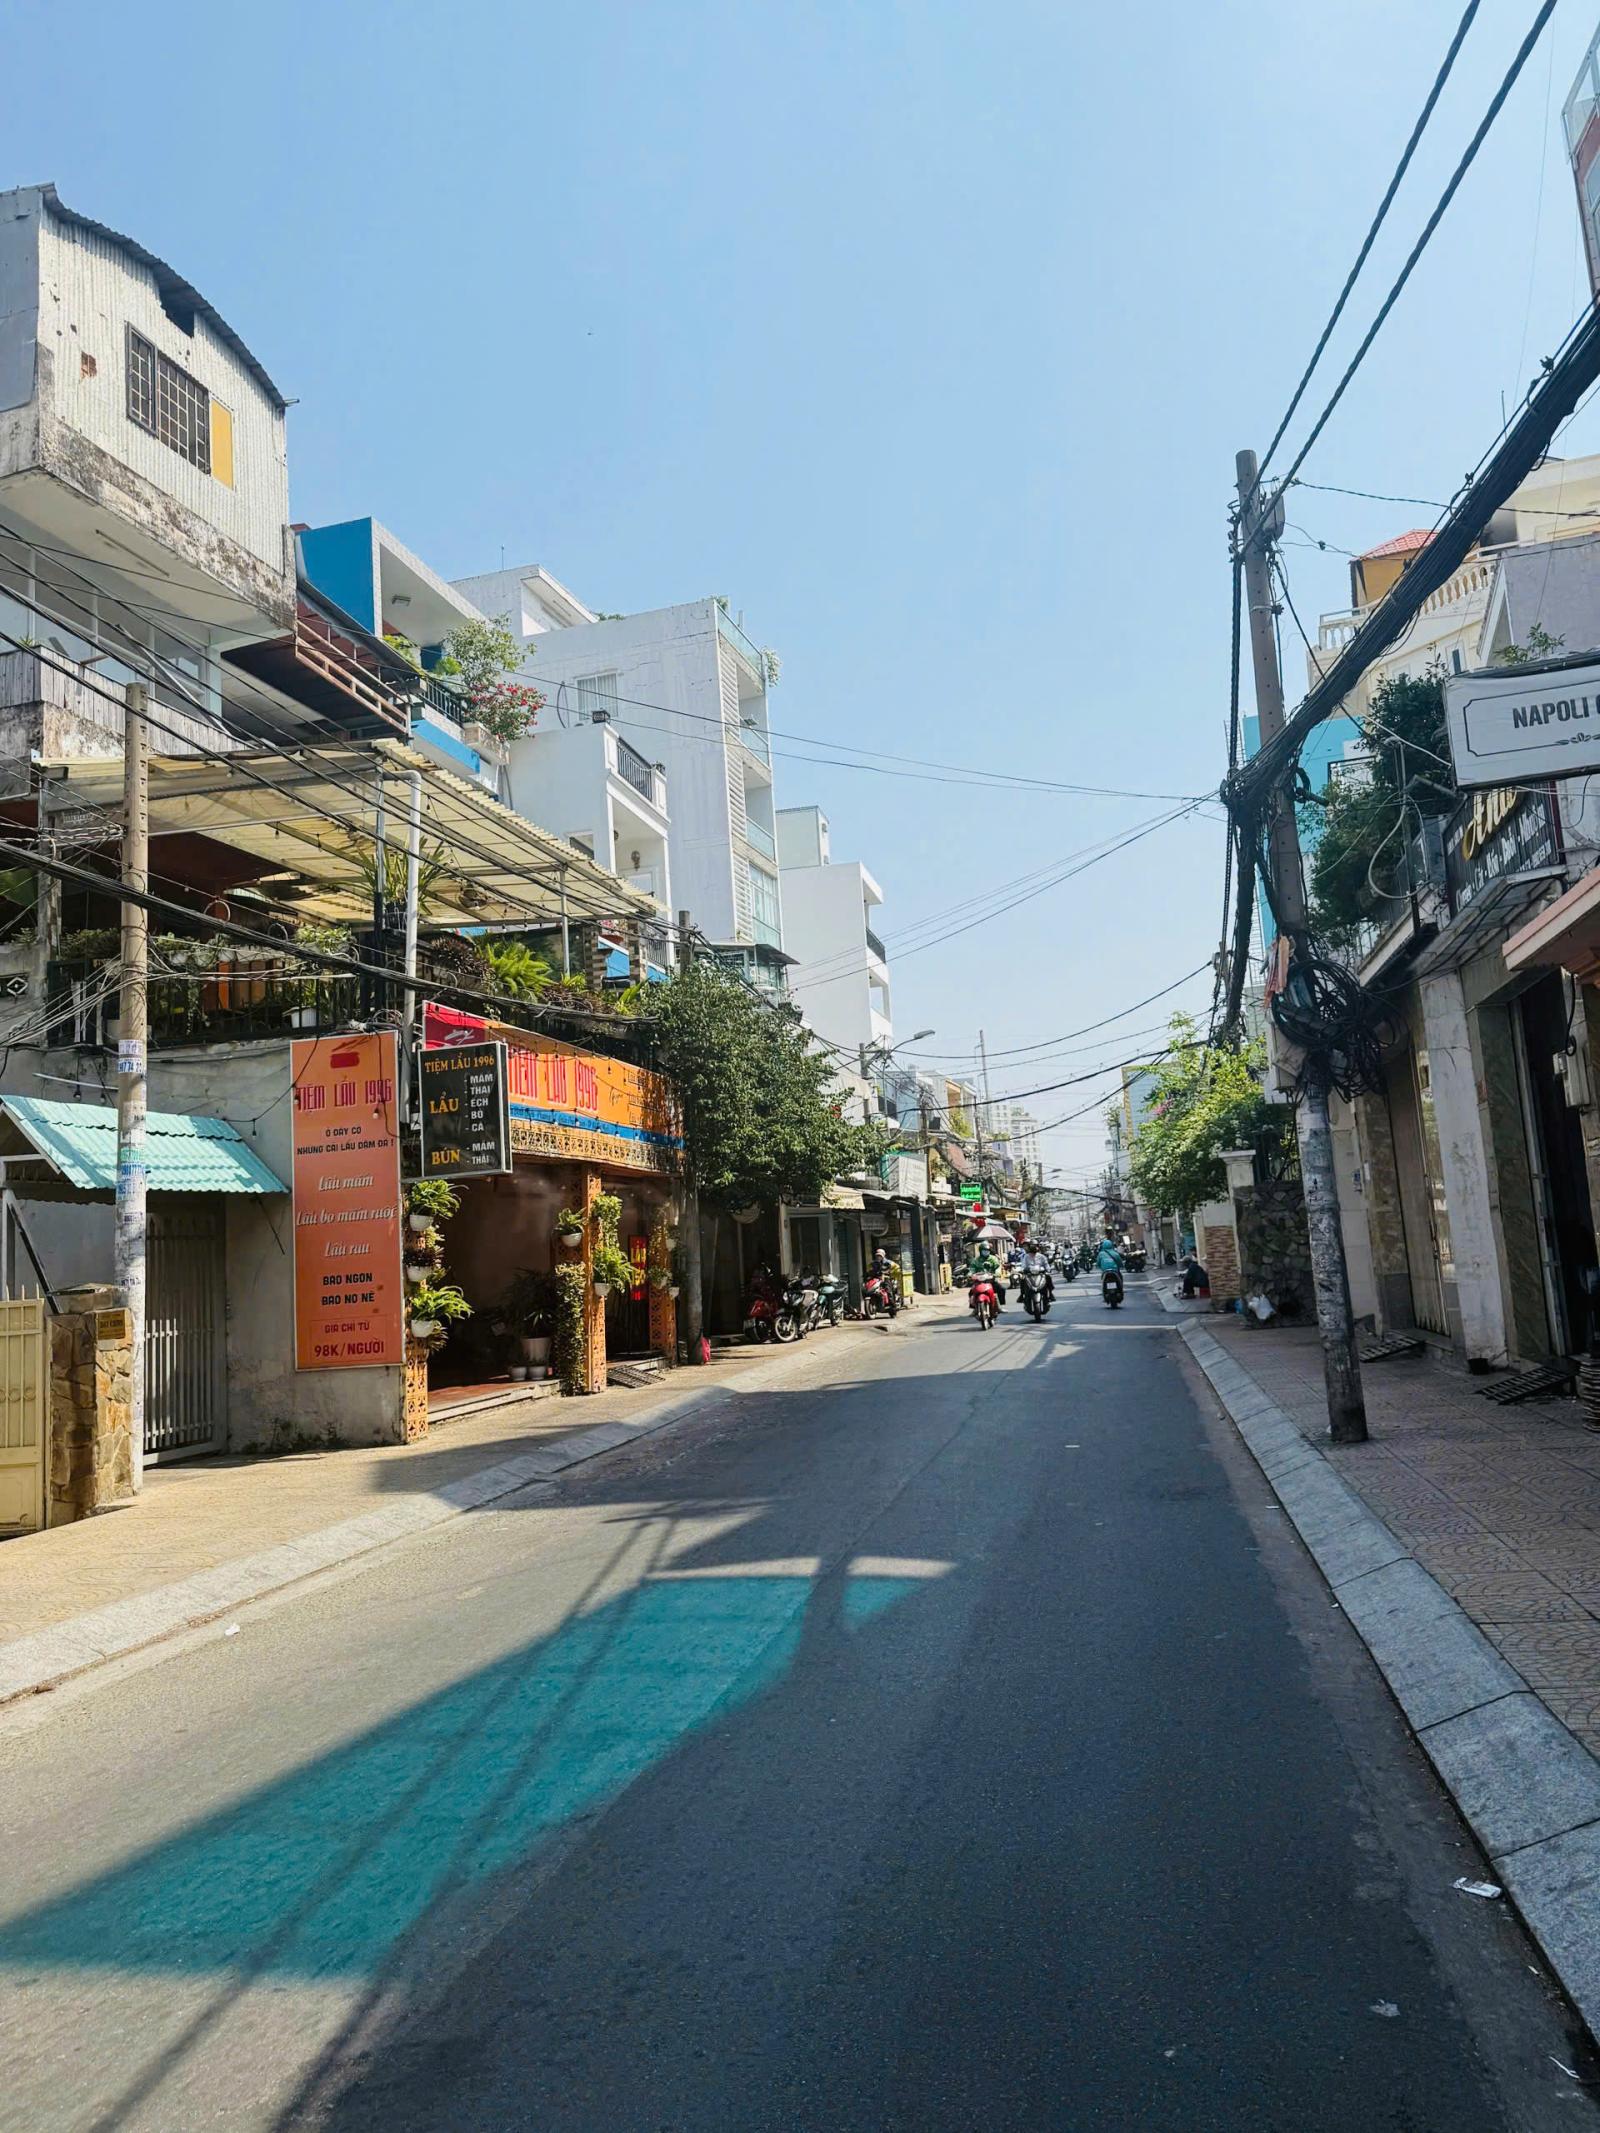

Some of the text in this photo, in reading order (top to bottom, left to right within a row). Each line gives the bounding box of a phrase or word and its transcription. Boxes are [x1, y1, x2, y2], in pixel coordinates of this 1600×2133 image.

[1512, 696, 1590, 729] NAPOLI
[423, 1051, 496, 1075] TIỆM LẨU 1996
[365, 1078, 392, 1105] 1996
[574, 1057, 598, 1112] 1996
[429, 1091, 459, 1115] LẨU
[431, 1146, 461, 1166] BÚN
[345, 1272, 373, 1284] NGON
